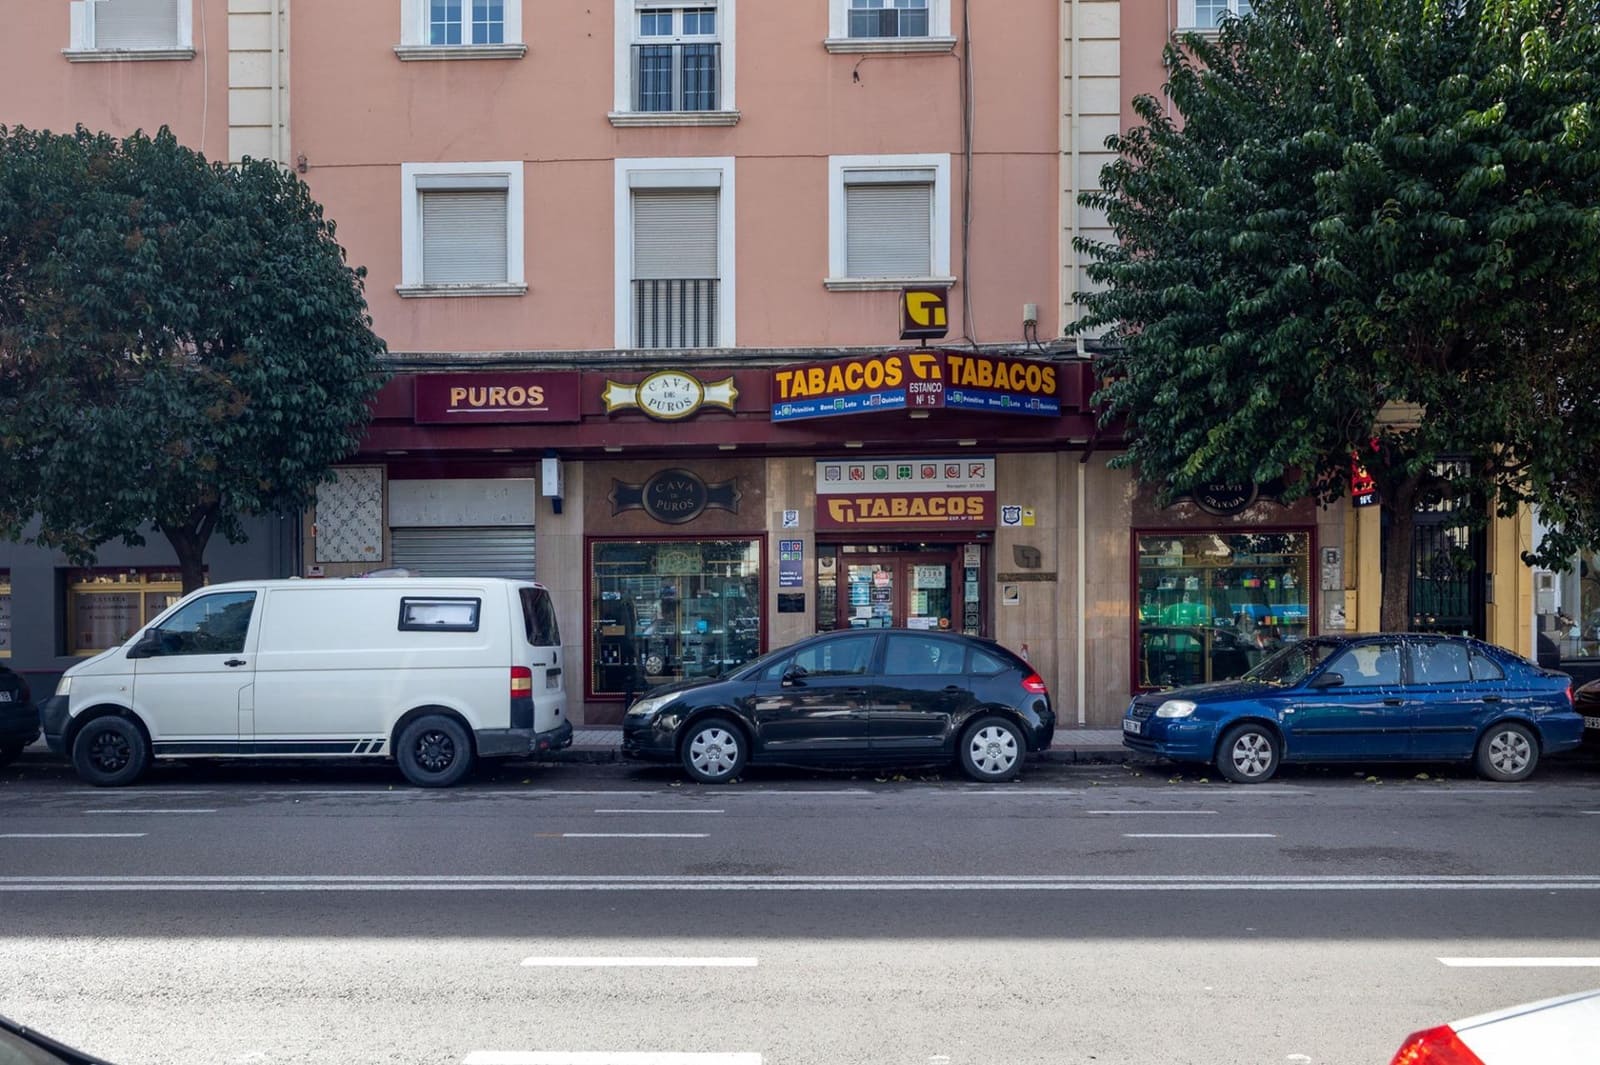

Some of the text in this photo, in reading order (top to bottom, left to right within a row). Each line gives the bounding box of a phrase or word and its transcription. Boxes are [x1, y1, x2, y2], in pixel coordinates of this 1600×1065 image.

[775, 356, 903, 398] TABACOS
[947, 356, 1056, 394] TABACOS
[648, 378, 691, 392] CAVA
[909, 382, 943, 393] ESTANCO
[450, 386, 545, 407] PUROS
[927, 395, 936, 405] 15
[648, 398, 692, 412] PUROS
[655, 481, 693, 493] CAVA
[656, 499, 695, 513] PUROS
[856, 496, 984, 517] TABACOS
